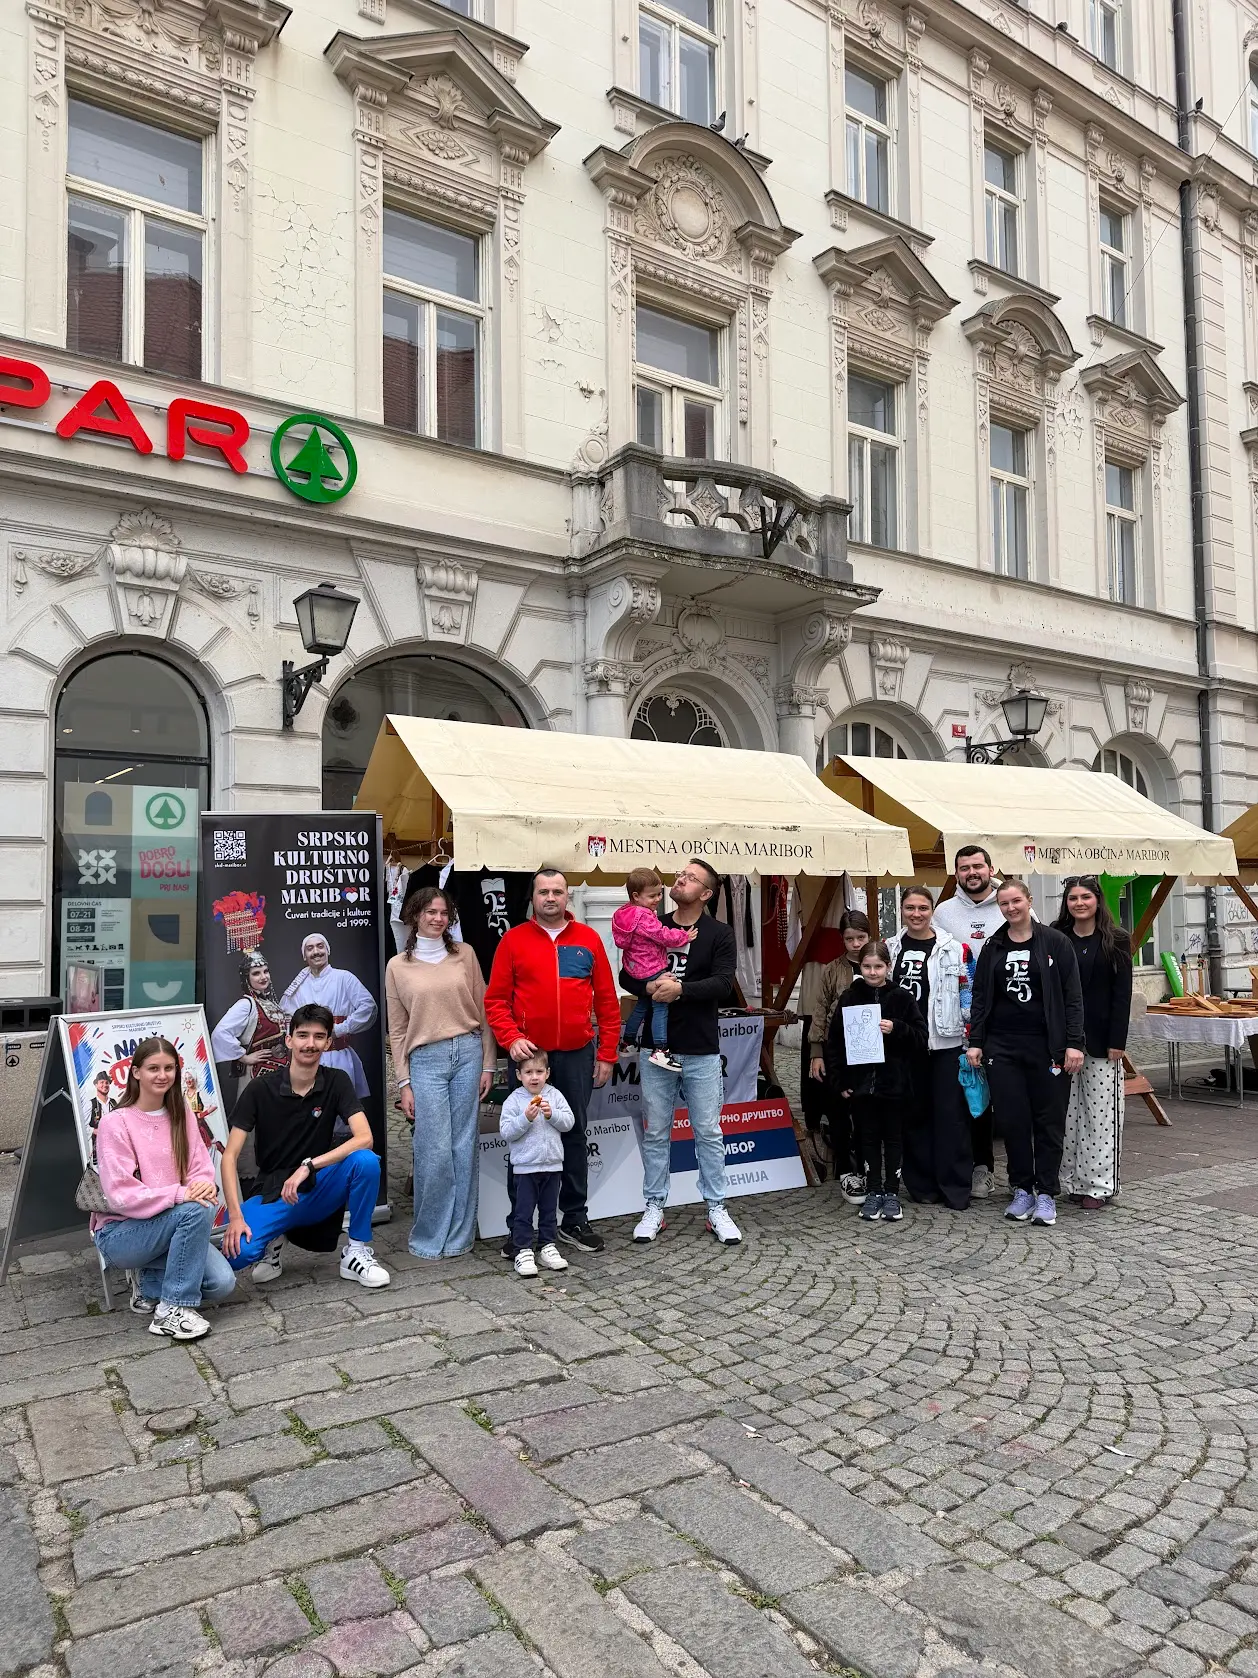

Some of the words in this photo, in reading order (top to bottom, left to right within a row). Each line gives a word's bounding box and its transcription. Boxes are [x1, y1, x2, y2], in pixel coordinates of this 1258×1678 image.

[298, 831, 369, 847] SRPSKO
[139, 846, 176, 861] DOBRO
[609, 838, 678, 854] MESTNA
[681, 838, 743, 855] OBČINA
[744, 842, 814, 858] MARIBOR
[1038, 847, 1083, 860] MESTNA
[1085, 846, 1124, 860] OBČINA
[1126, 849, 1170, 861] MARIBOR
[274, 850, 370, 866] KULTURNO
[286, 866, 370, 885] DRUŠTVO
[285, 908, 309, 920] Čuvari
[311, 910, 341, 919] tradicije
[347, 909, 371, 917] kulture
[336, 920, 348, 928] od
[349, 919, 371, 927] 1999.
[608, 1092, 640, 1104] Mesto
[673, 1119, 691, 1129] СКО
[718, 1113, 740, 1124] УРНО
[741, 1108, 784, 1123] ДРУШТВО
[479, 1138, 507, 1152] rpsko
[594, 1122, 631, 1136] Maribor
[724, 1141, 756, 1155] ИБОР
[725, 1170, 769, 1187] ВЕНИЈА
